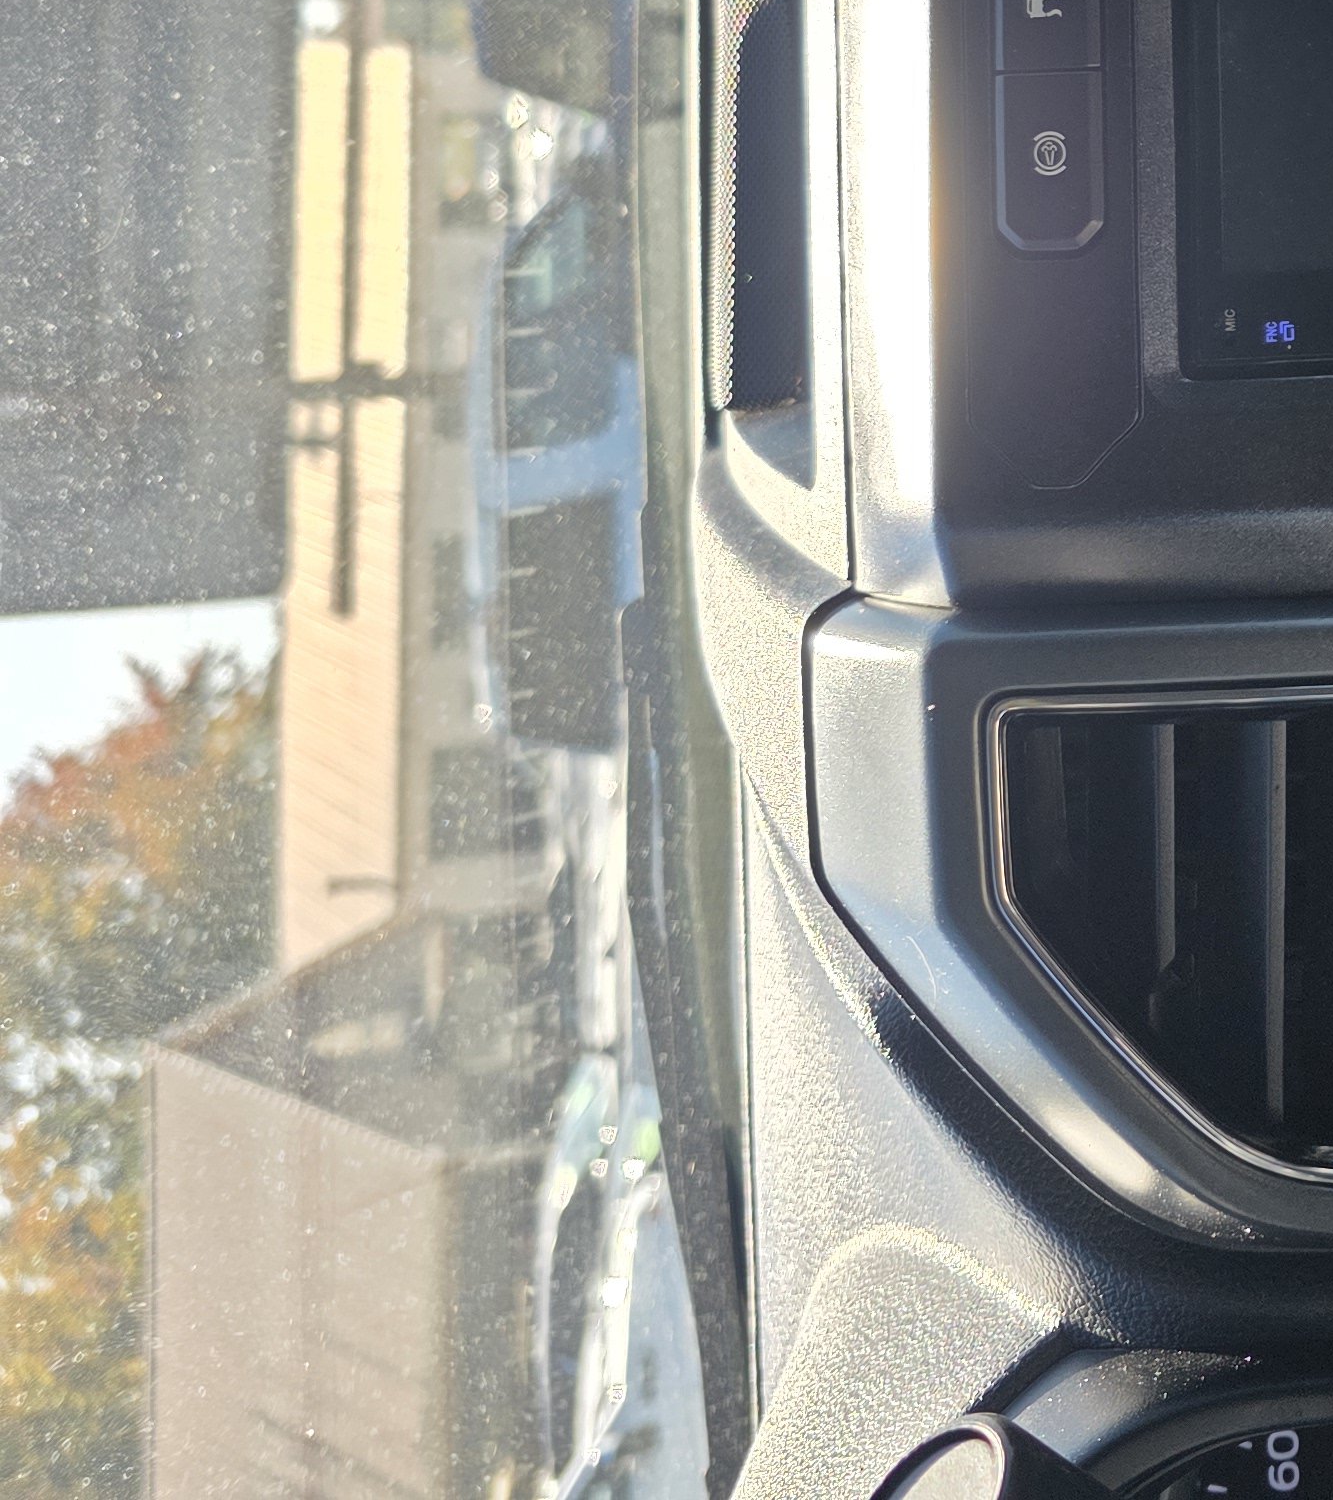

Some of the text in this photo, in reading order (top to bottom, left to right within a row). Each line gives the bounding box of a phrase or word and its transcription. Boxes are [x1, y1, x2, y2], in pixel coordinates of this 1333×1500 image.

[1225, 309, 1236, 332] MIC
[1266, 320, 1278, 343] FNC
[1267, 1430, 1300, 1492] 60
